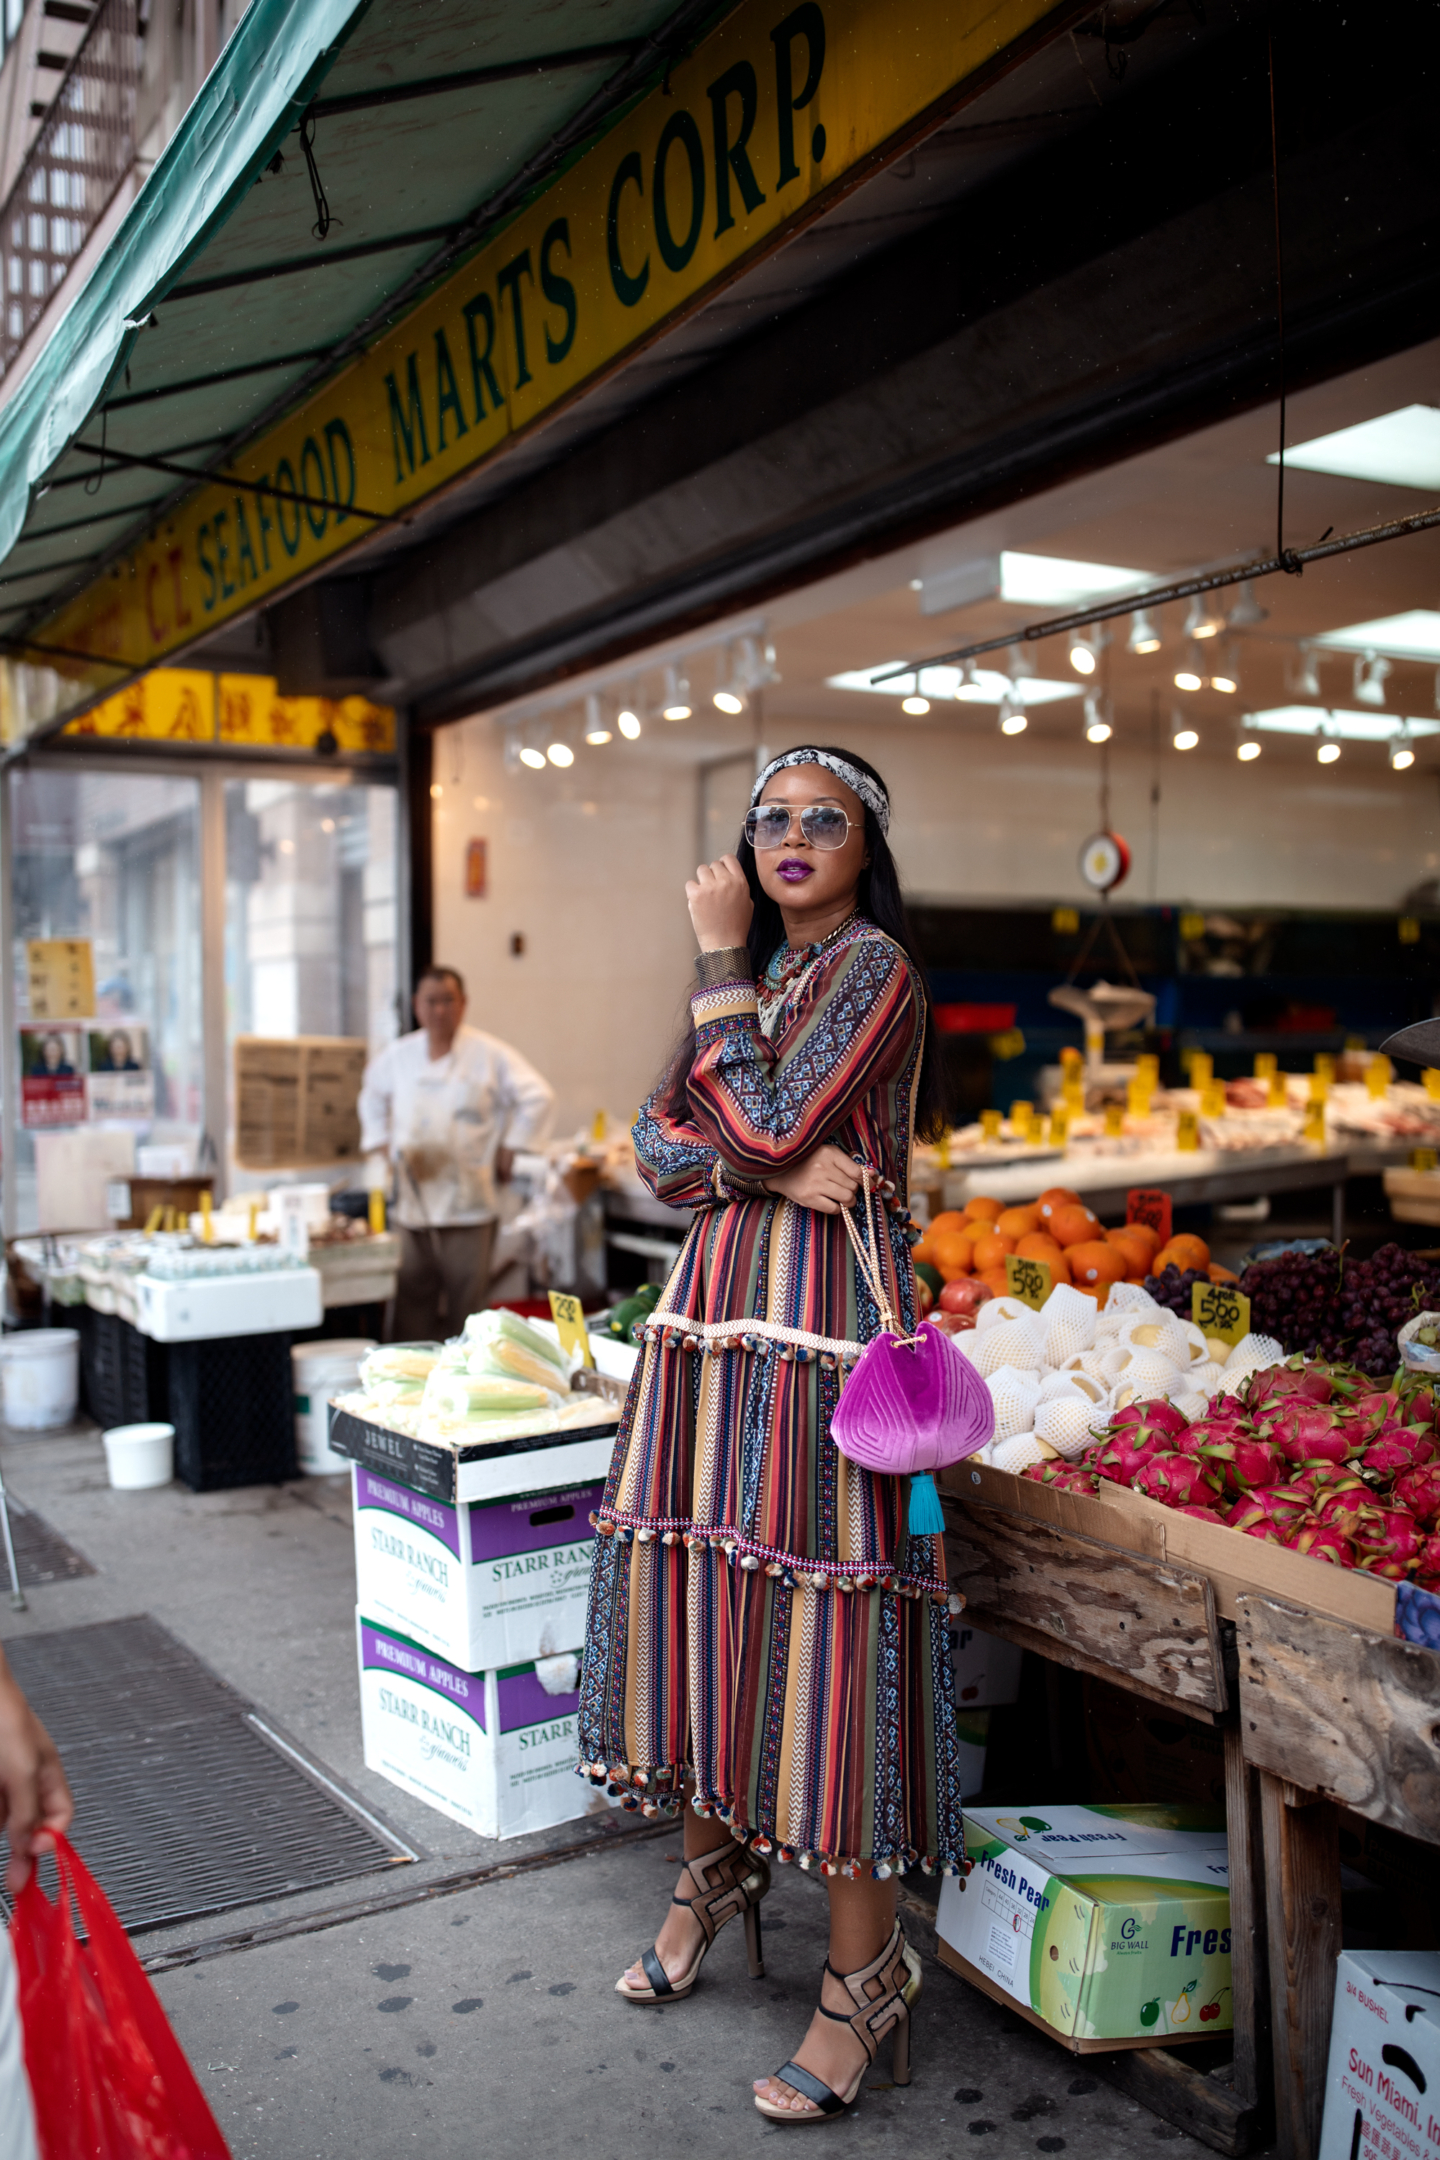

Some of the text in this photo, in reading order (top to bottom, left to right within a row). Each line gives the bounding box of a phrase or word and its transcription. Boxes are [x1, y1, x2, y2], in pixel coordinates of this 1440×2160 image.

[199, 417, 356, 612] SEAFOOD
[385, 217, 577, 486] MARTS
[607, 2, 826, 307] CORP.
[365, 1430, 404, 1459] JEWEL
[367, 1477, 445, 1529] PREMIUM APPLES
[511, 1496, 558, 1513] PREMIUM
[560, 1489, 593, 1503] APPLES
[371, 1526, 449, 1588] STARR RANCH
[492, 1554, 549, 1582] STARR
[375, 1638, 469, 1698] PREMIUM APPLES
[379, 1686, 471, 1757] STARR RANCH
[519, 1720, 573, 1751] STARR
[1041, 1833, 1128, 1843] Fresh Pear
[980, 1850, 1050, 1912] Fresh Pear
[1110, 1940, 1149, 1950] BIG WALL
[979, 1954, 1014, 1988] HEBEI CHINA
[1346, 1981, 1389, 2024] 3/4 BUSHEL
[1349, 2048, 1374, 2087] Sun
[1377, 2071, 1422, 2131] Miami,
[1342, 2075, 1366, 2109] Fresh
[1370, 2099, 1421, 2157] Vegetables
